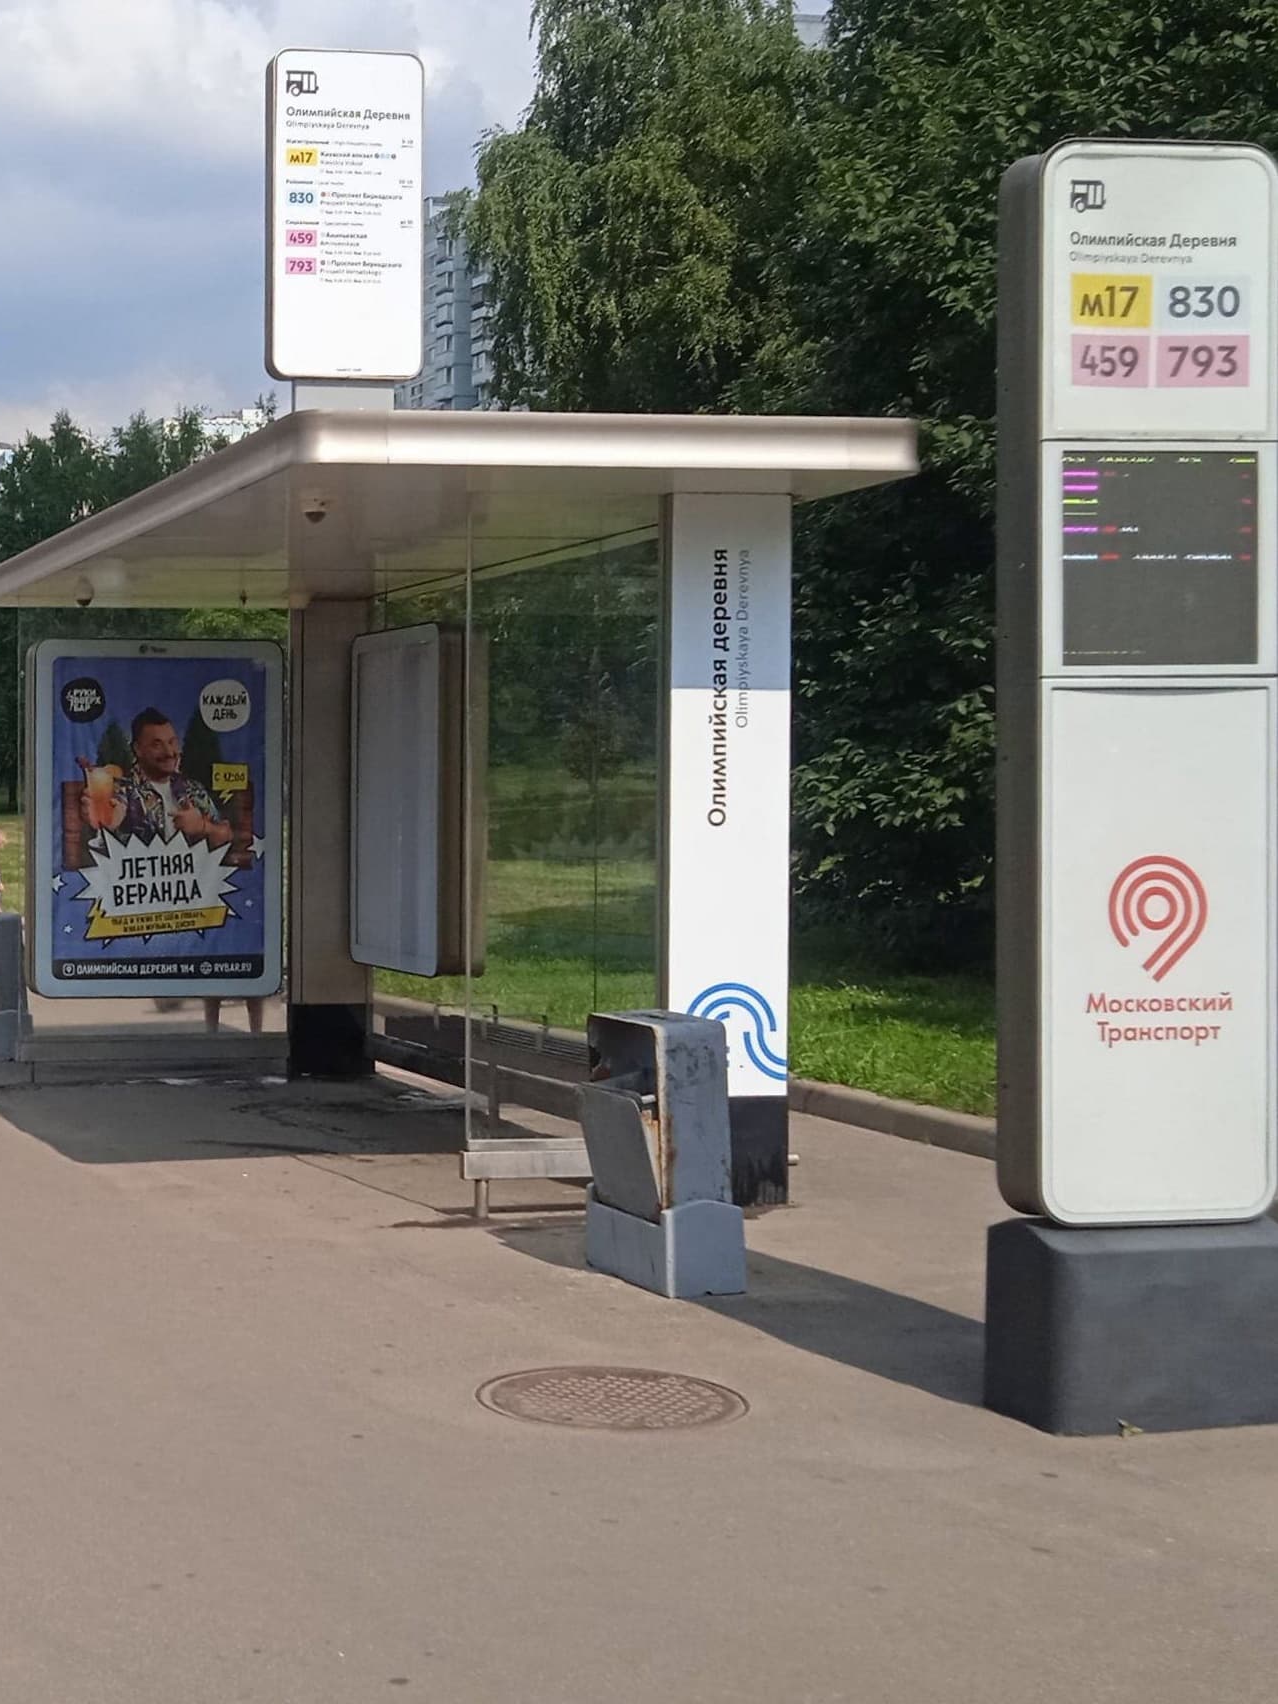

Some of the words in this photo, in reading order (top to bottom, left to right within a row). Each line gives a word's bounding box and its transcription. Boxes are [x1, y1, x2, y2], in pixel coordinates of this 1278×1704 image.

[286, 106, 361, 119] Олимпийская
[363, 108, 411, 121] Деревня
[289, 192, 314, 204] 830
[289, 233, 313, 244] 459
[1070, 231, 1166, 248] Олимпийская
[1169, 233, 1237, 250] Деревня
[289, 260, 313, 272] 793
[1168, 286, 1240, 318] 830
[1080, 345, 1139, 378] 459
[1168, 346, 1238, 378] 793
[736, 549, 752, 621] Derevnya
[713, 548, 731, 652] деревня
[735, 626, 752, 728] Olimpiyskaya
[202, 691, 248, 708] КАЖДЫЙ
[212, 707, 237, 721] ДЕНЬ
[707, 658, 728, 826] Олимпийская
[119, 853, 194, 881] ЛЕТНЯЯ
[113, 879, 202, 907] ВЕРАНДА
[77, 962, 138, 975] ОЛИМПИЙСКАЯ
[139, 964, 178, 975] ДЕРЕВНЯ
[1086, 992, 1233, 1013] Московский
[1097, 1021, 1221, 1048] Транспорт
